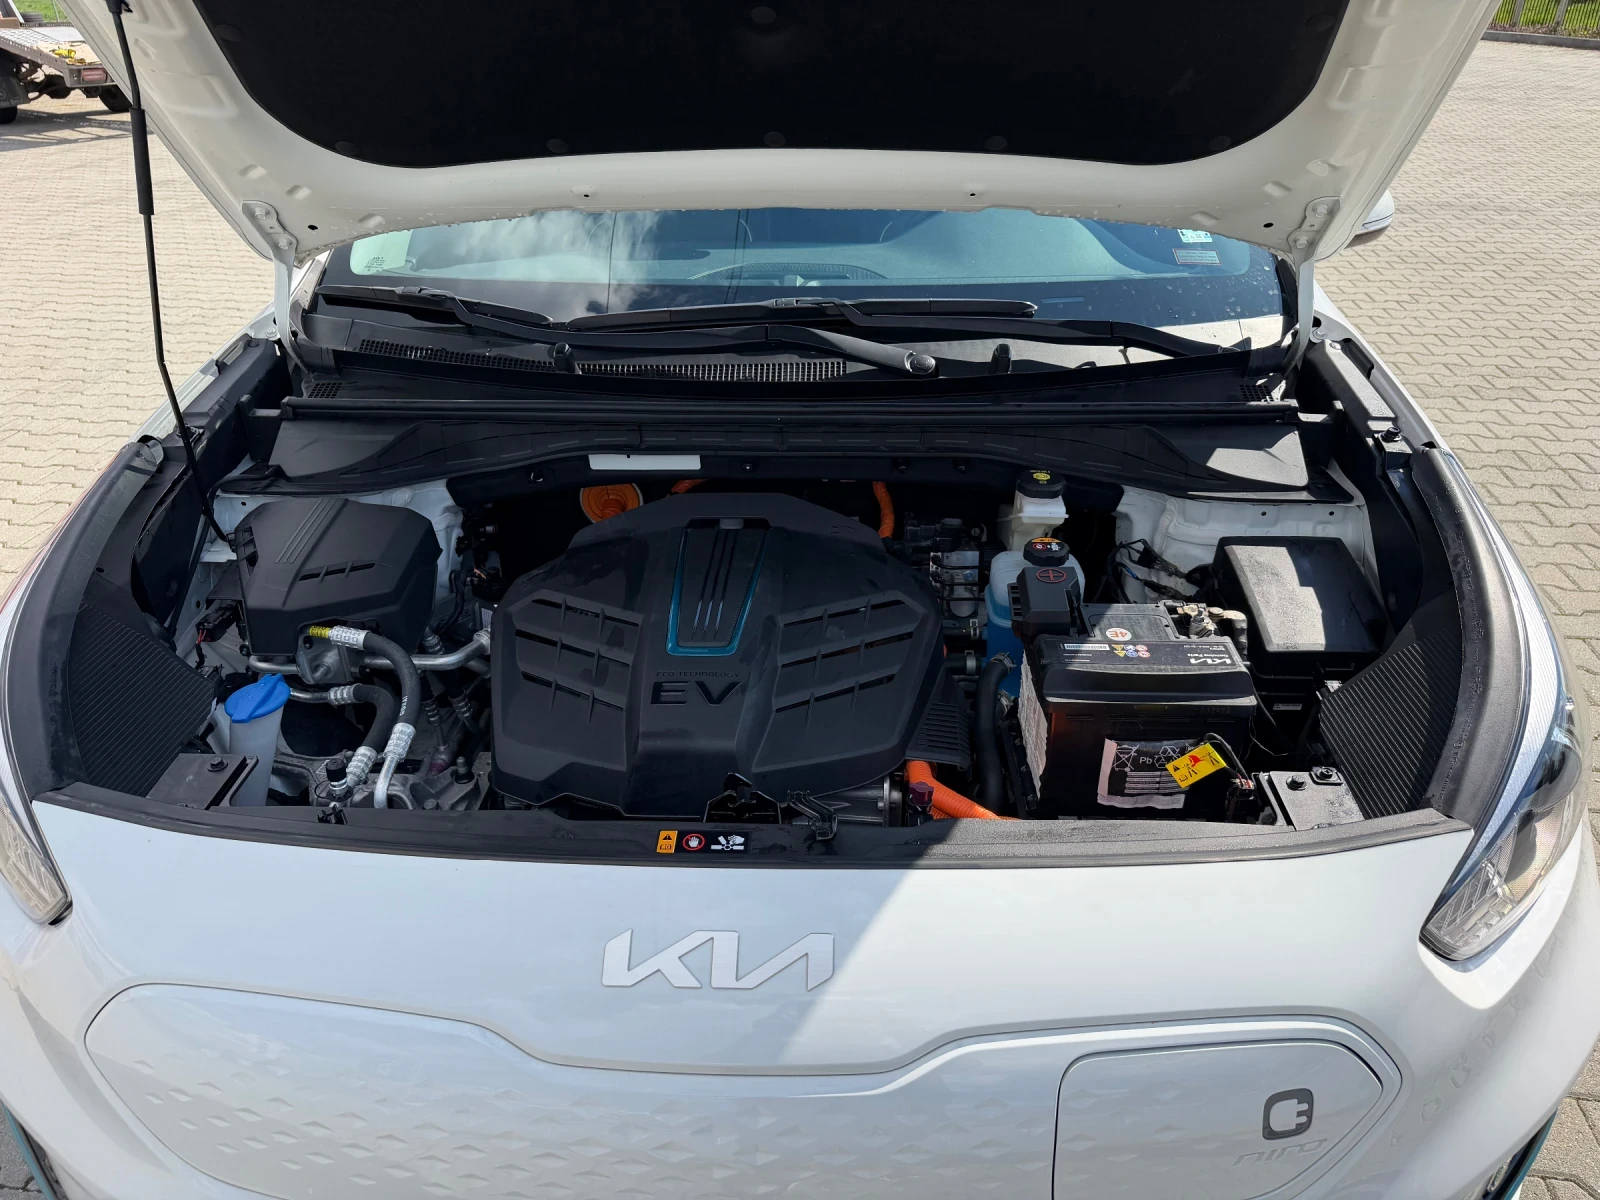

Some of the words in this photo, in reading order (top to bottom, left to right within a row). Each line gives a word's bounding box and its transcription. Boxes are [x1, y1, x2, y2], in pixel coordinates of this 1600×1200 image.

[1109, 630, 1128, 638] 4E
[650, 681, 741, 705] EV
[1139, 756, 1153, 764] Pb
[601, 928, 835, 992] KIA
[1232, 1137, 1329, 1167] niro
